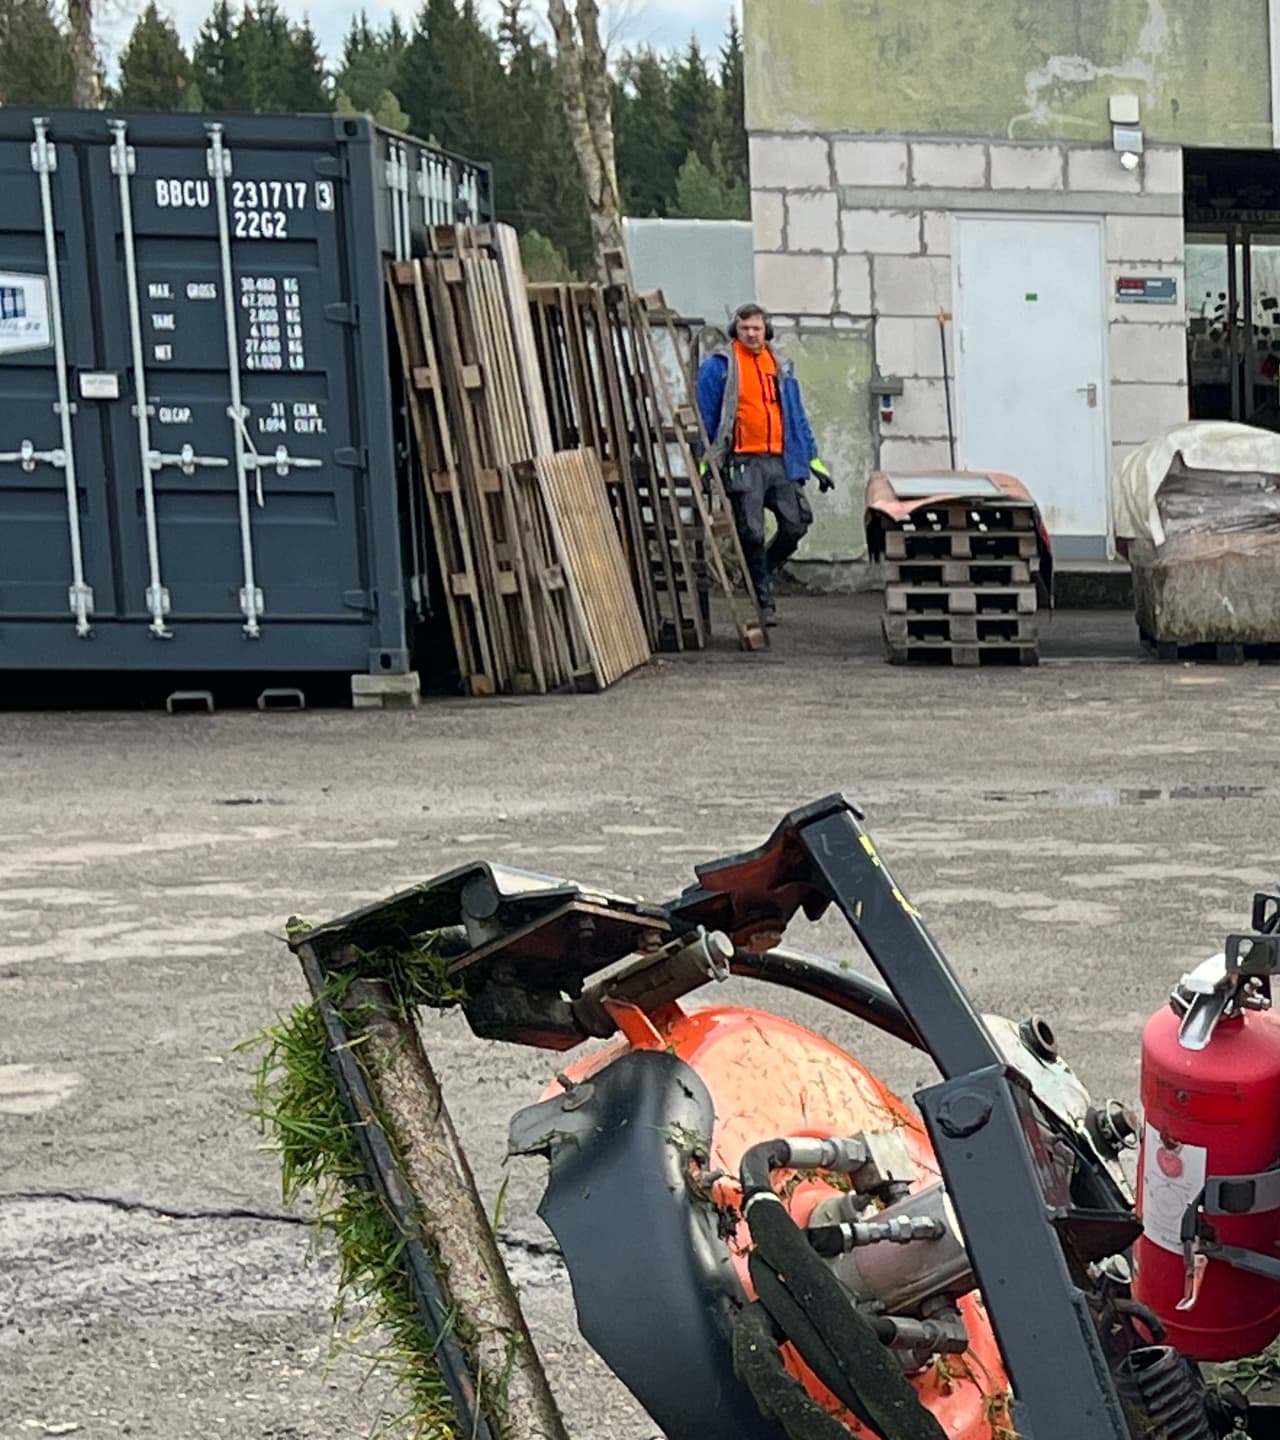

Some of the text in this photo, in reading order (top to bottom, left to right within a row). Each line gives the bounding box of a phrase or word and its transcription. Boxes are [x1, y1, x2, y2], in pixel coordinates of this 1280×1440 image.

[155, 179, 332, 210] BBCU 231717 3
[234, 211, 288, 239] 22G2
[186, 283, 217, 299] GROSS
[283, 277, 299, 292] KG
[284, 293, 300, 308] LB
[285, 308, 301, 323] KG
[287, 324, 302, 338] LB
[154, 344, 173, 361] NET
[288, 339, 303, 353] KG
[289, 354, 305, 370] LB
[271, 402, 285, 417] 31
